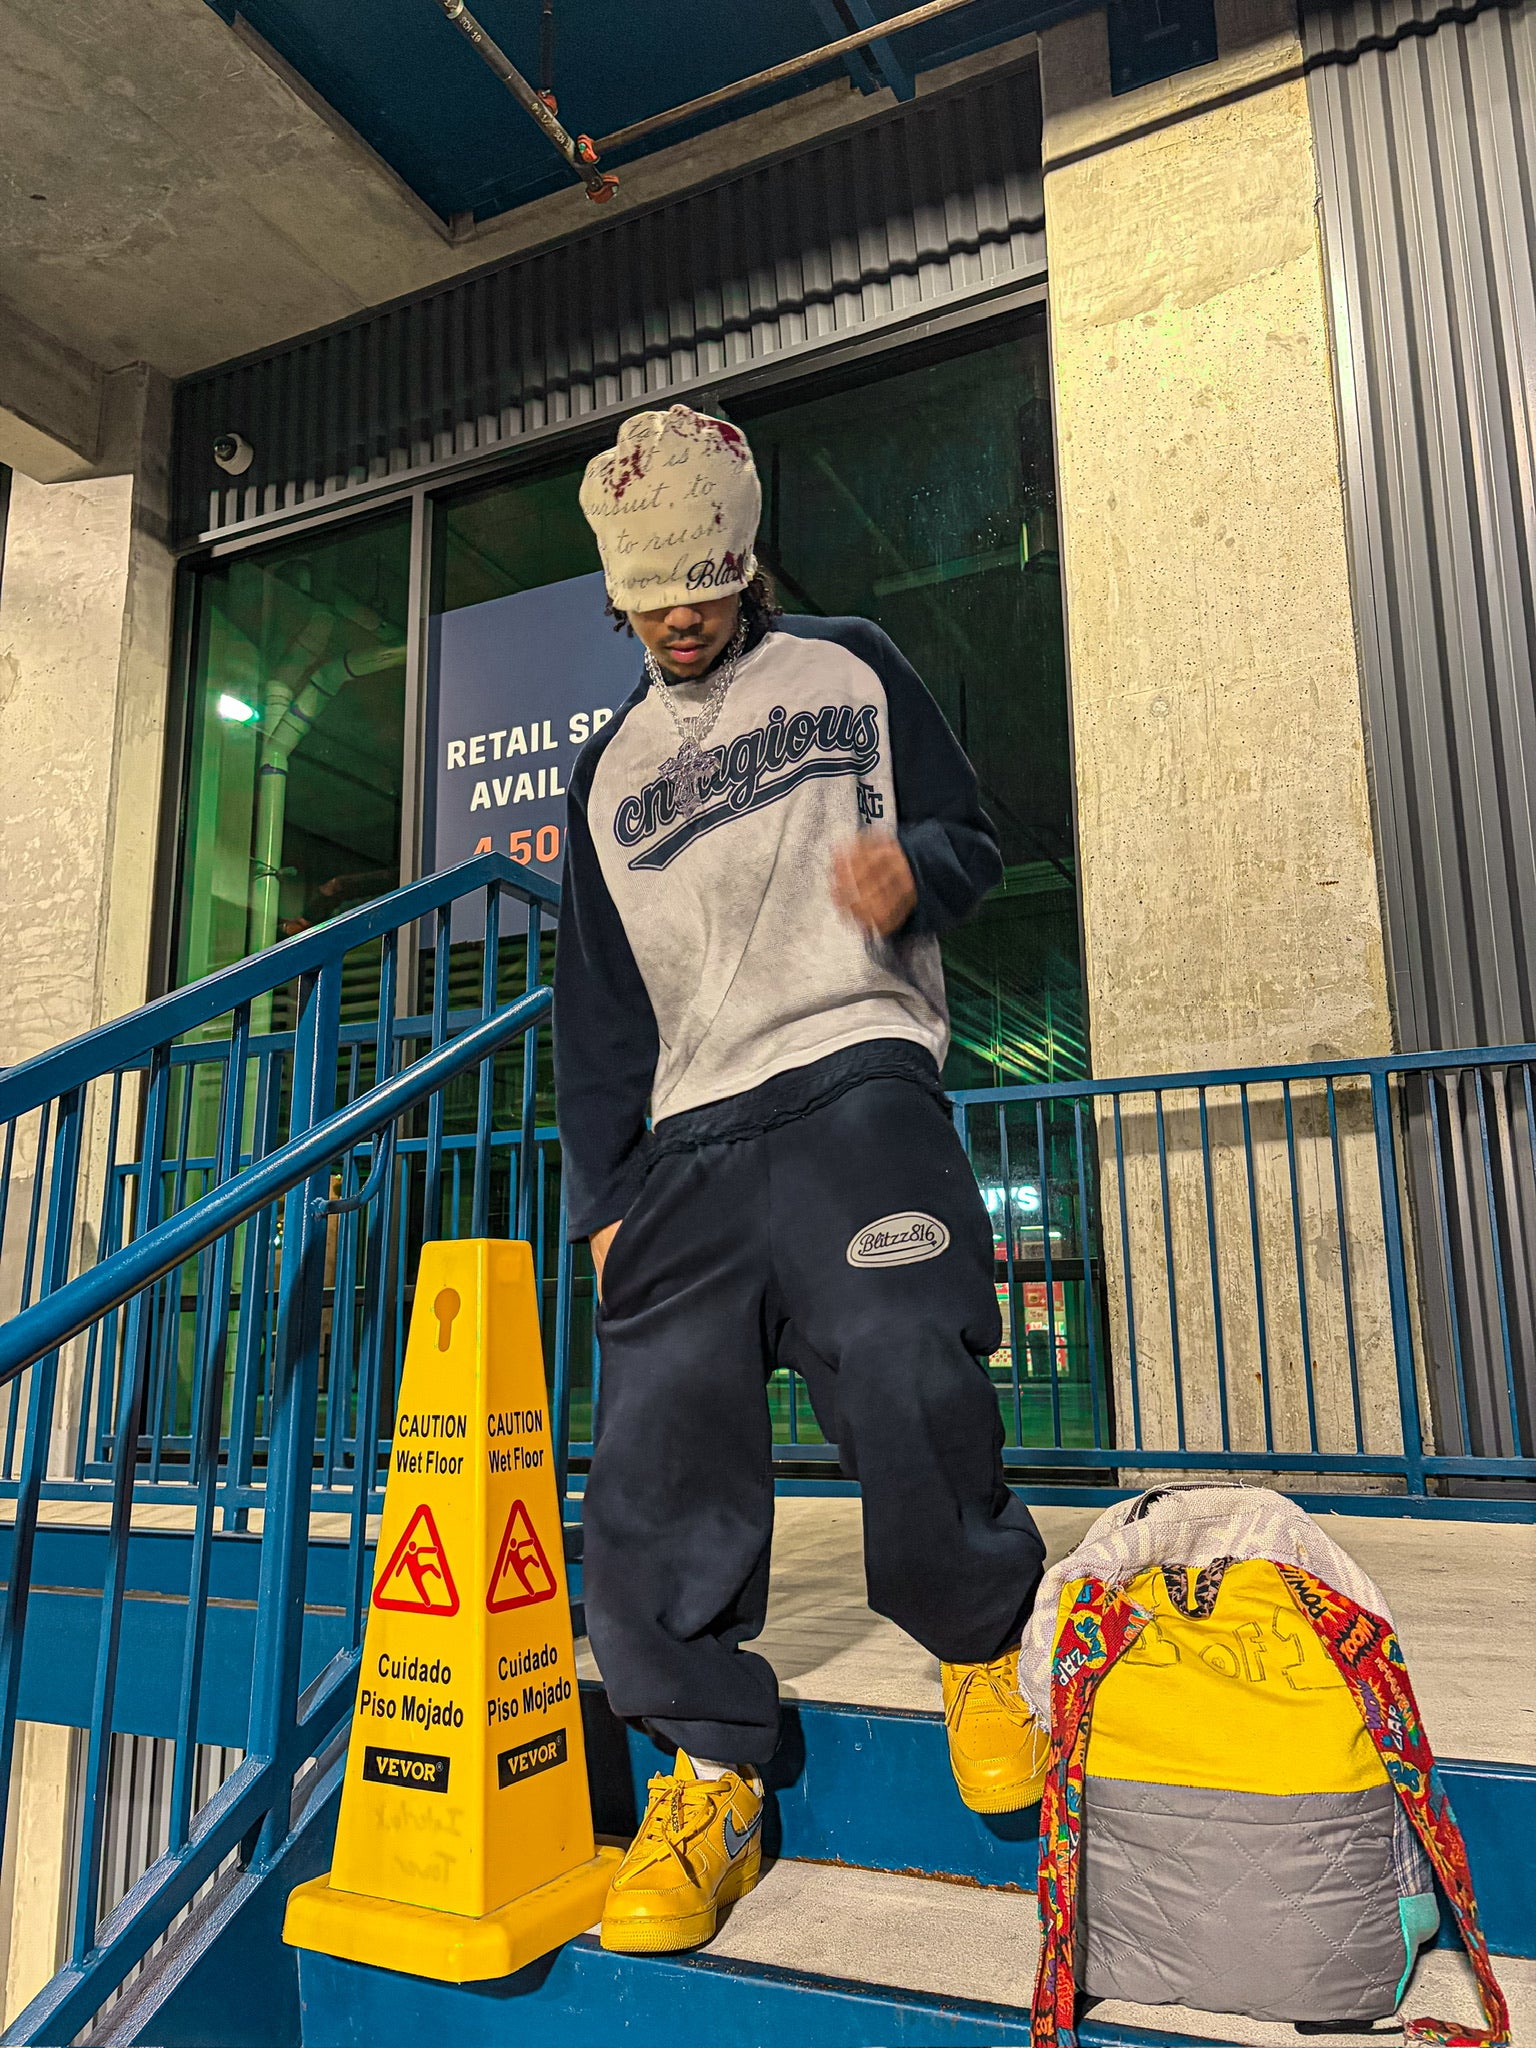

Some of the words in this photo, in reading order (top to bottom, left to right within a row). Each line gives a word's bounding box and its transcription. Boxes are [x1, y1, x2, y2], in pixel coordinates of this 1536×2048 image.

[447, 719, 559, 770] RETAIL
[470, 766, 566, 813] AVAIL
[859, 1223, 936, 1253] Blitzz816
[399, 1414, 467, 1438] CAUTION
[487, 1409, 543, 1438] CAUTION
[396, 1450, 423, 1474] Wet
[426, 1450, 464, 1475] Floor
[488, 1449, 512, 1474] Wet
[513, 1447, 544, 1470] Floor
[377, 1653, 452, 1685] Cuidado
[498, 1643, 558, 1681] Cuidado
[1057, 1647, 1088, 1686] ZAP
[359, 1690, 397, 1719] Piso
[401, 1695, 464, 1731] Mojado
[487, 1697, 519, 1726] Piso
[522, 1676, 572, 1714] Mojado
